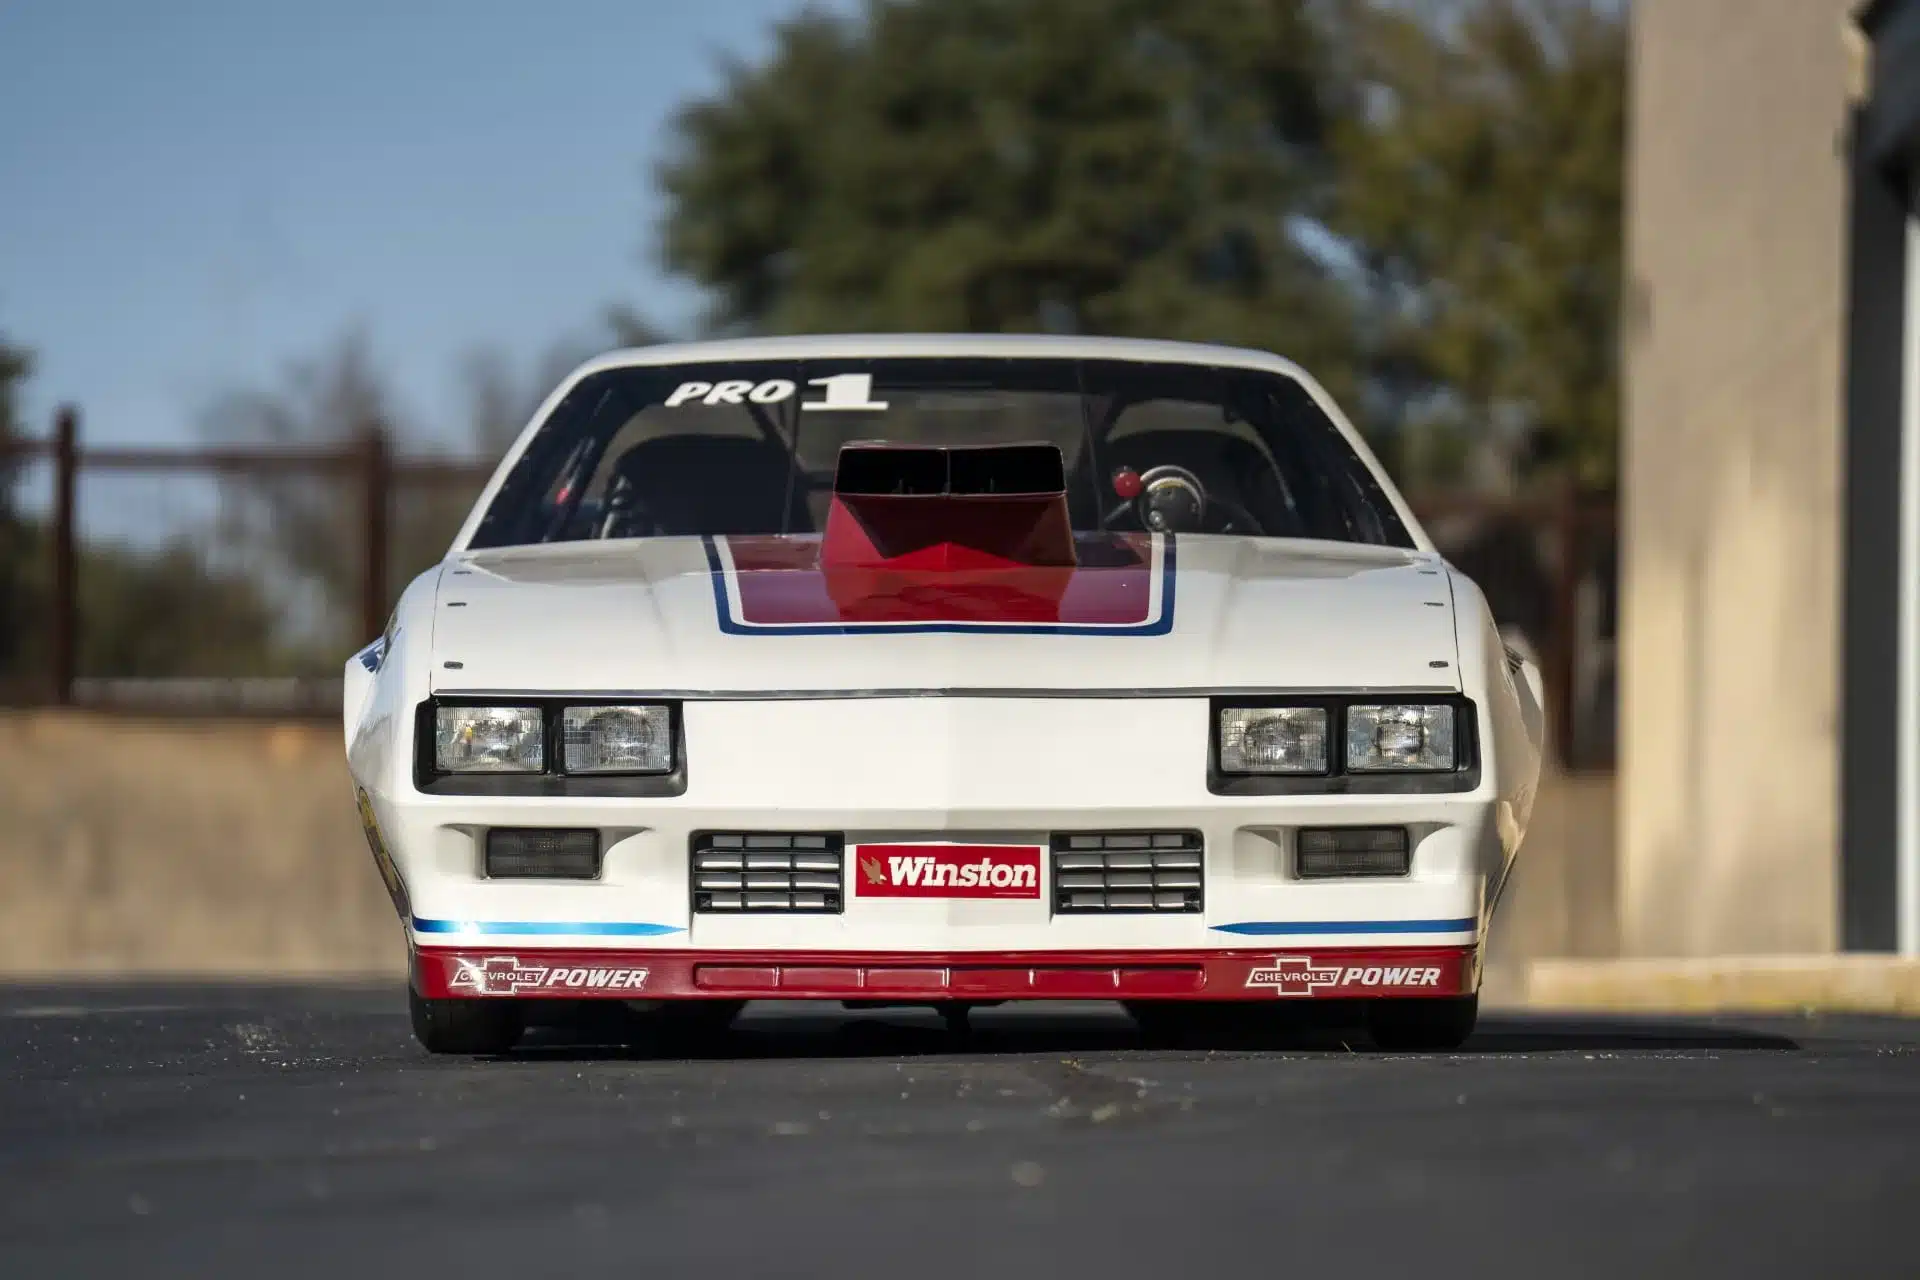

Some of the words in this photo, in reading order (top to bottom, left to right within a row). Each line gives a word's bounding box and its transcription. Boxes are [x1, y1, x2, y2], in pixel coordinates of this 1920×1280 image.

[664, 379, 796, 407] PRO
[801, 373, 889, 410] 1
[888, 856, 1037, 888] Winston
[459, 971, 541, 982] CEVROLET
[548, 968, 648, 988] POWER
[1254, 971, 1336, 982] CHEVROLET
[1342, 967, 1441, 986] POWER
